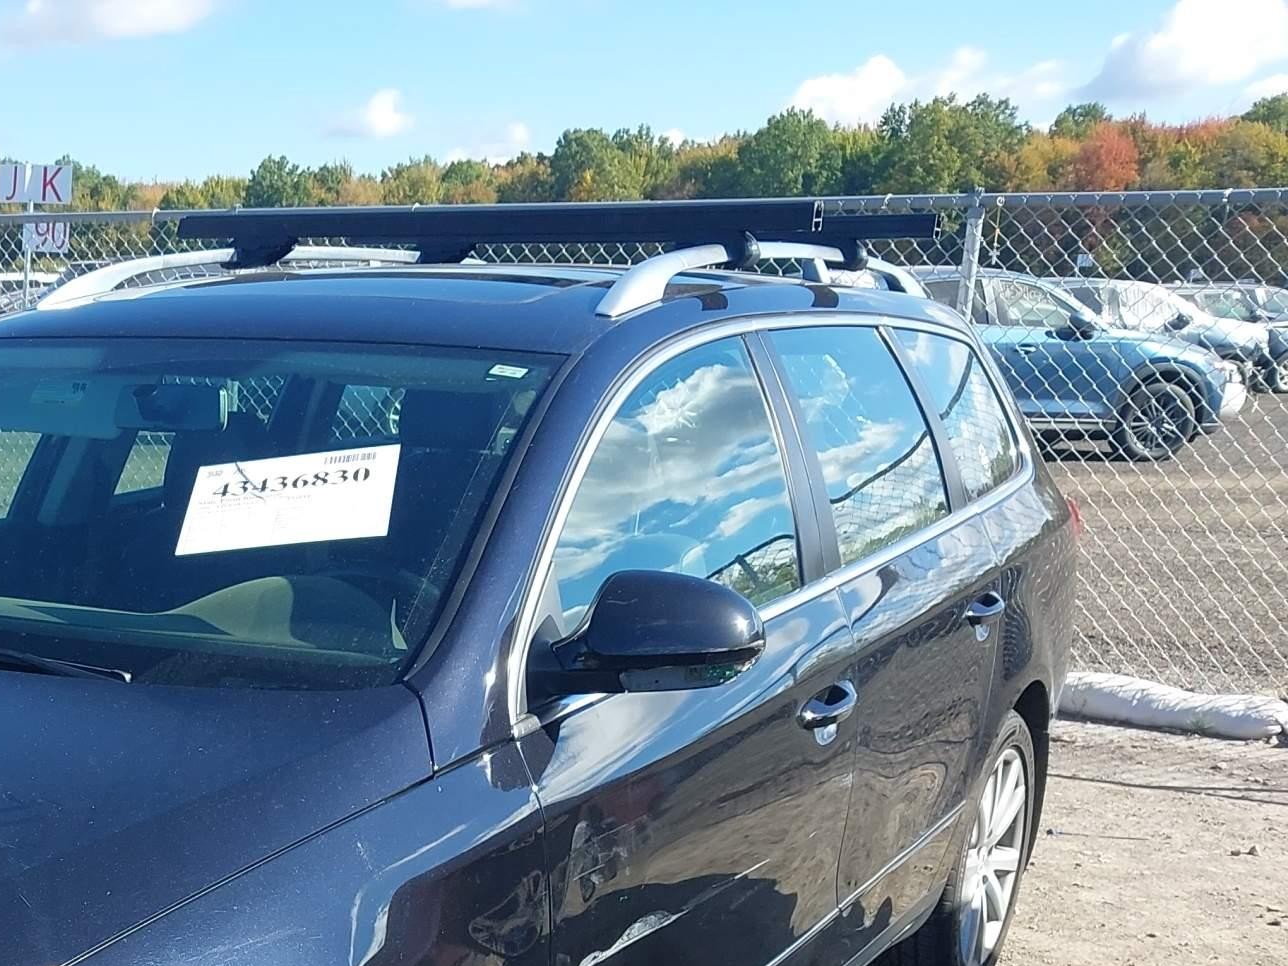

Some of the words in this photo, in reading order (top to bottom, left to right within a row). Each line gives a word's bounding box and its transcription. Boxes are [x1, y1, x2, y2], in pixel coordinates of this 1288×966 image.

[6, 166, 18, 200] J
[42, 166, 63, 201] K
[35, 221, 67, 249] 90
[212, 467, 371, 497] 43436830
